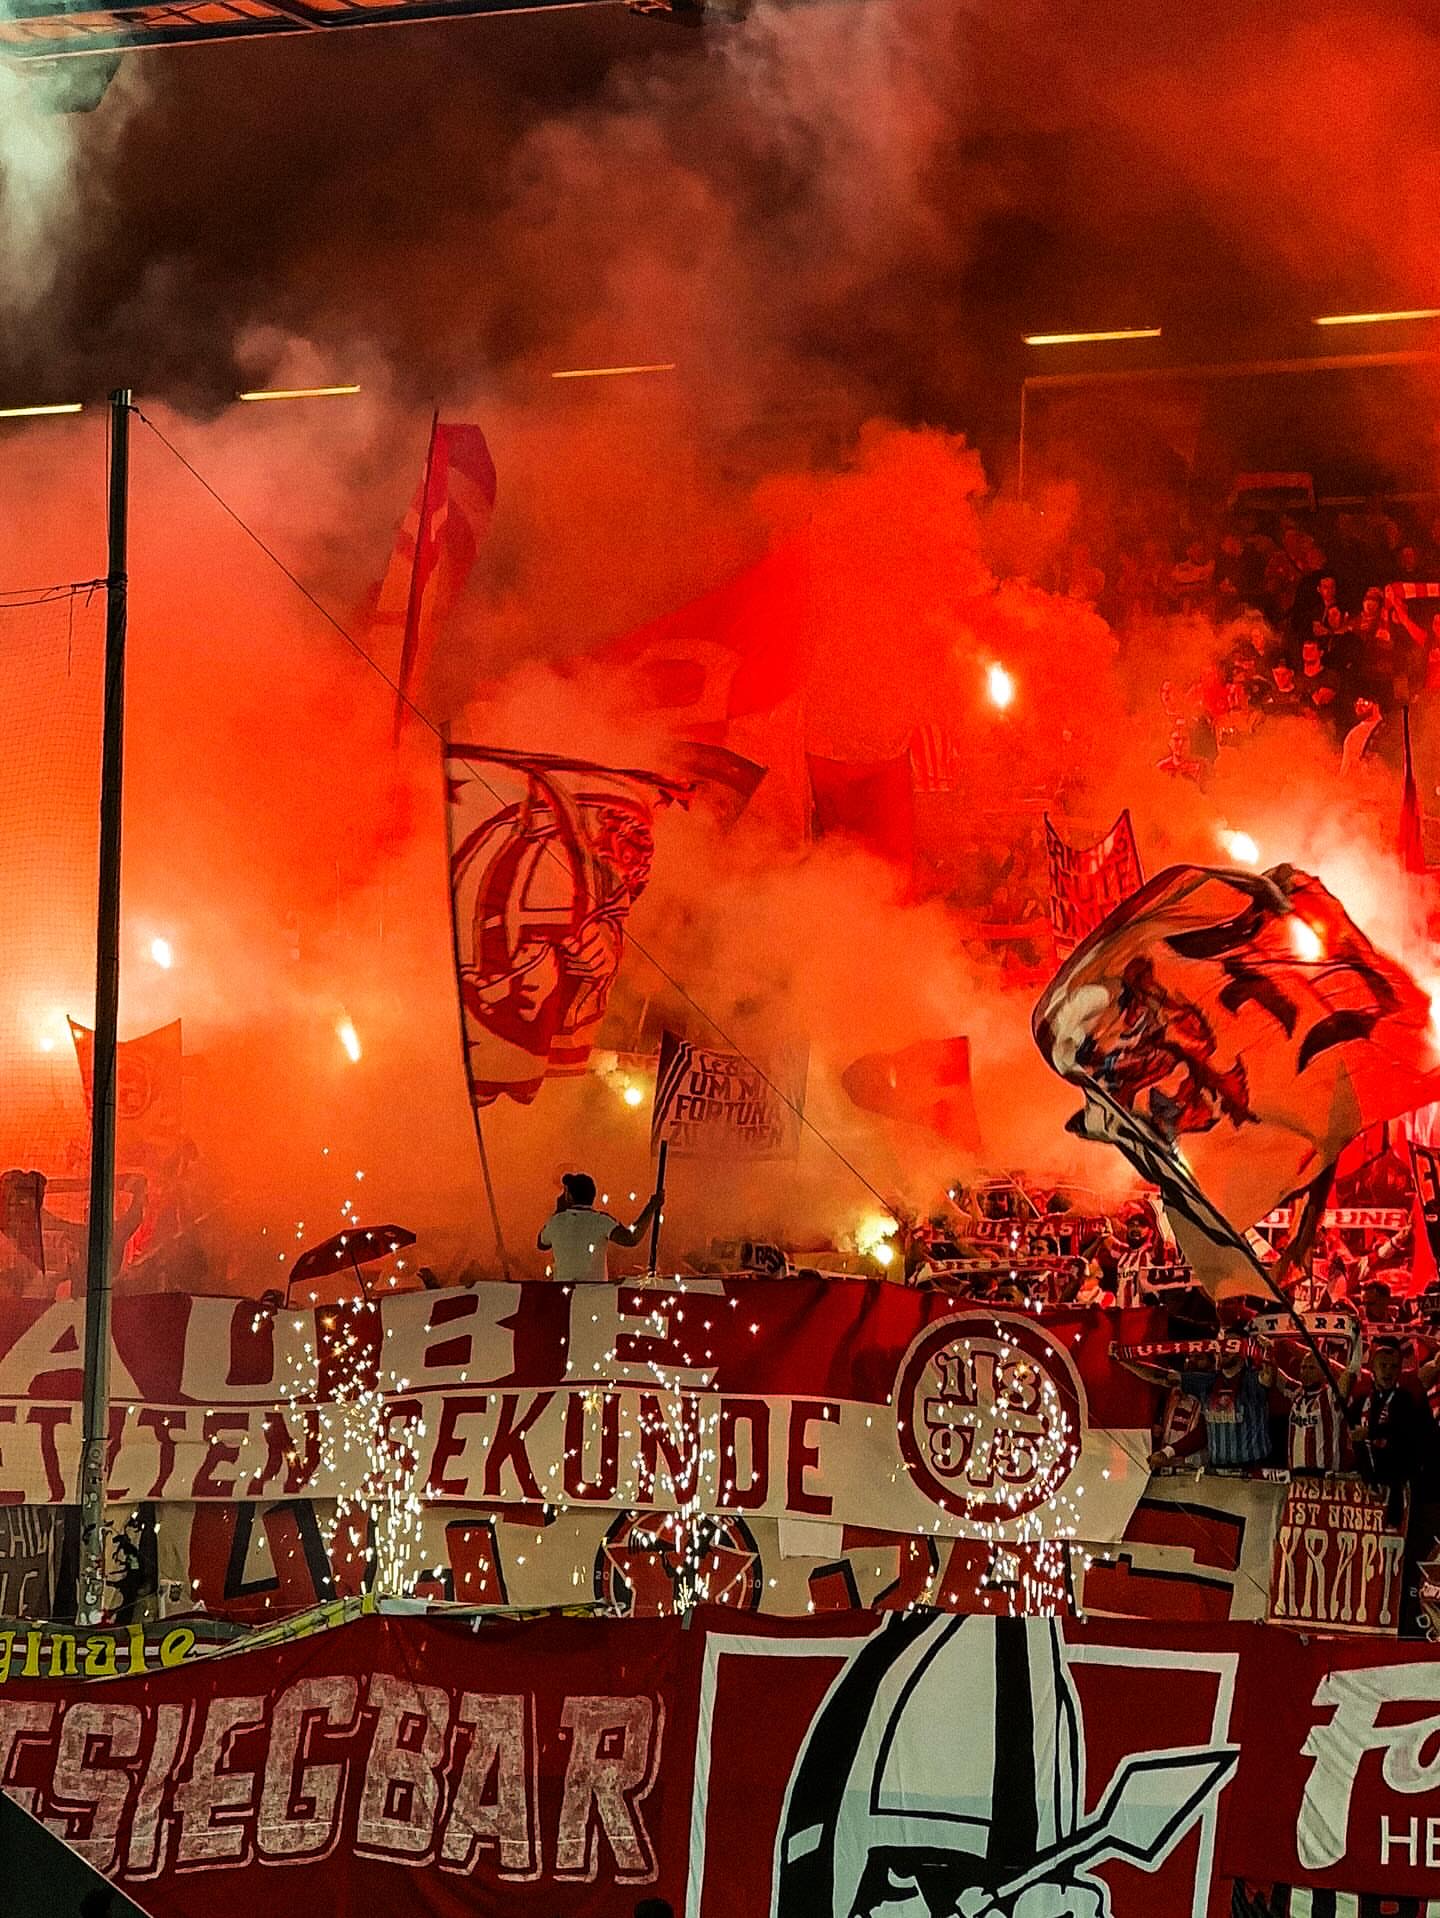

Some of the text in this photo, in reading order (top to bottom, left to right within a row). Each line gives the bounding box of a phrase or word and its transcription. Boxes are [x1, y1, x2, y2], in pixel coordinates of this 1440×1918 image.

[690, 1070, 731, 1100] UM
[976, 1222, 1074, 1237] ULTRAS
[362, 1391, 841, 1516] SEKUNDE
[1288, 1501, 1398, 1534] IST UNSER
[1274, 1525, 1406, 1625] KRAFT
